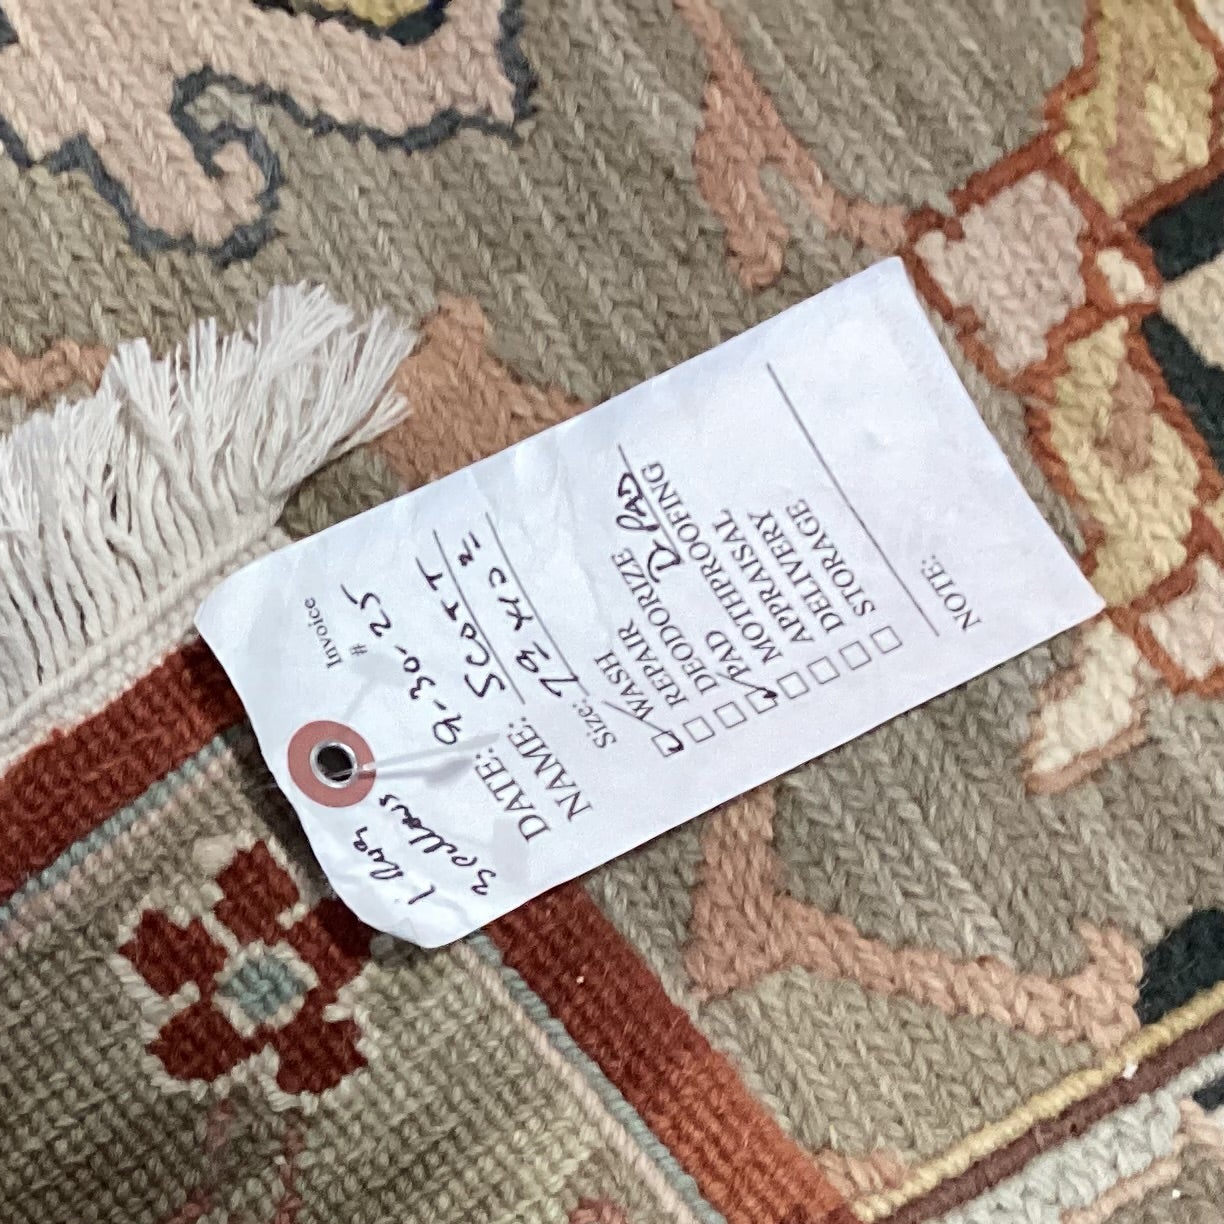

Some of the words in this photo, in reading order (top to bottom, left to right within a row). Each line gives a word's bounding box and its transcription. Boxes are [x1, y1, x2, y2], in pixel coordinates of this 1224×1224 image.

[639, 460, 784, 666] MOTHPROOFING
[710, 507, 816, 644] APPRAISAL
[745, 508, 846, 635] DELIVERY
[784, 497, 877, 618] STORAGE
[919, 553, 983, 633] NOTE:
[303, 596, 344, 670] Invoice
[348, 642, 368, 657] #
[609, 546, 721, 696] DEODORIZE
[616, 616, 690, 710] REPAIR
[703, 628, 753, 685] PAD
[570, 697, 618, 749] Size:
[591, 647, 655, 725] WASH
[464, 746, 552, 843] DATE:
[505, 715, 593, 823] NAME:
[405, 882, 437, 906] 1
[468, 867, 497, 897] 3
